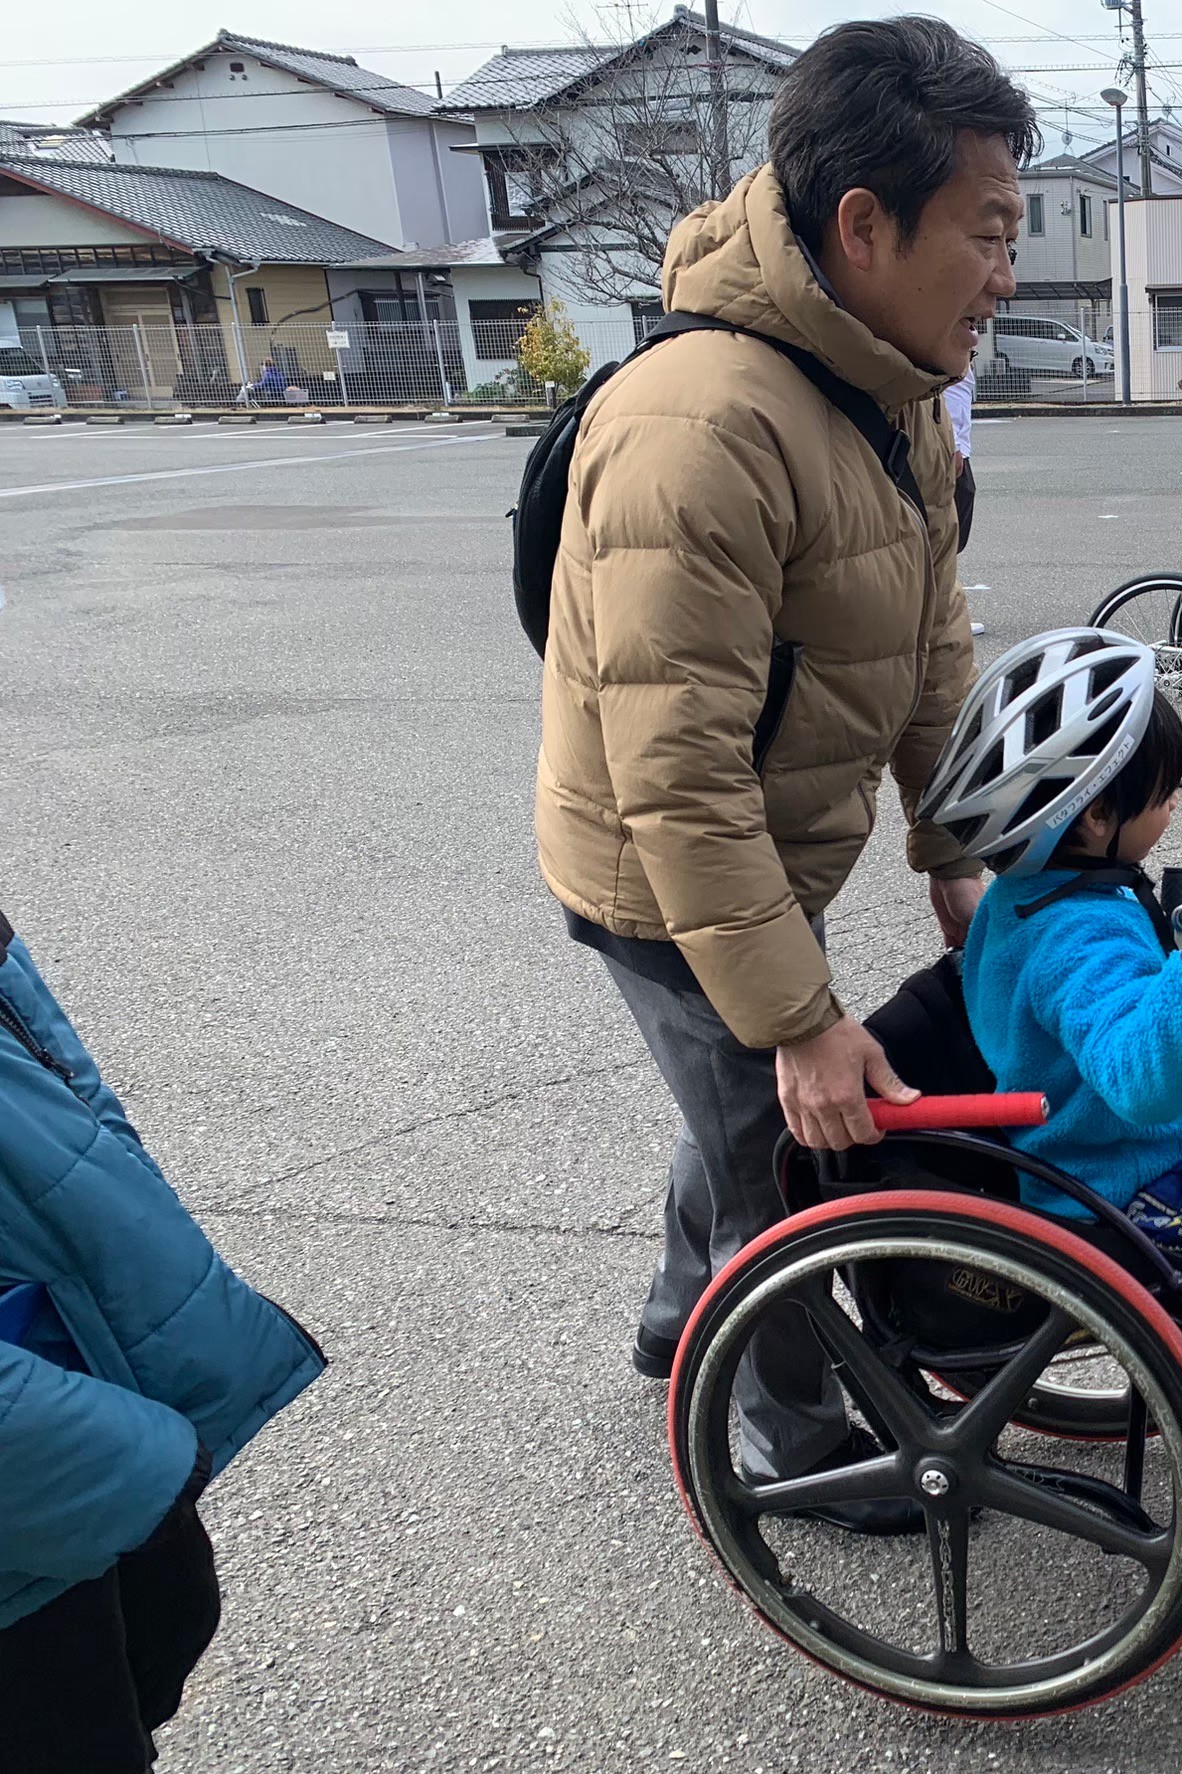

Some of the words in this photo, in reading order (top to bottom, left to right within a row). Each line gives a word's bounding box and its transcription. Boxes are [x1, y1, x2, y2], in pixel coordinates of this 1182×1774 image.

[1051, 740, 1132, 828] バタフライ・エフェクト
